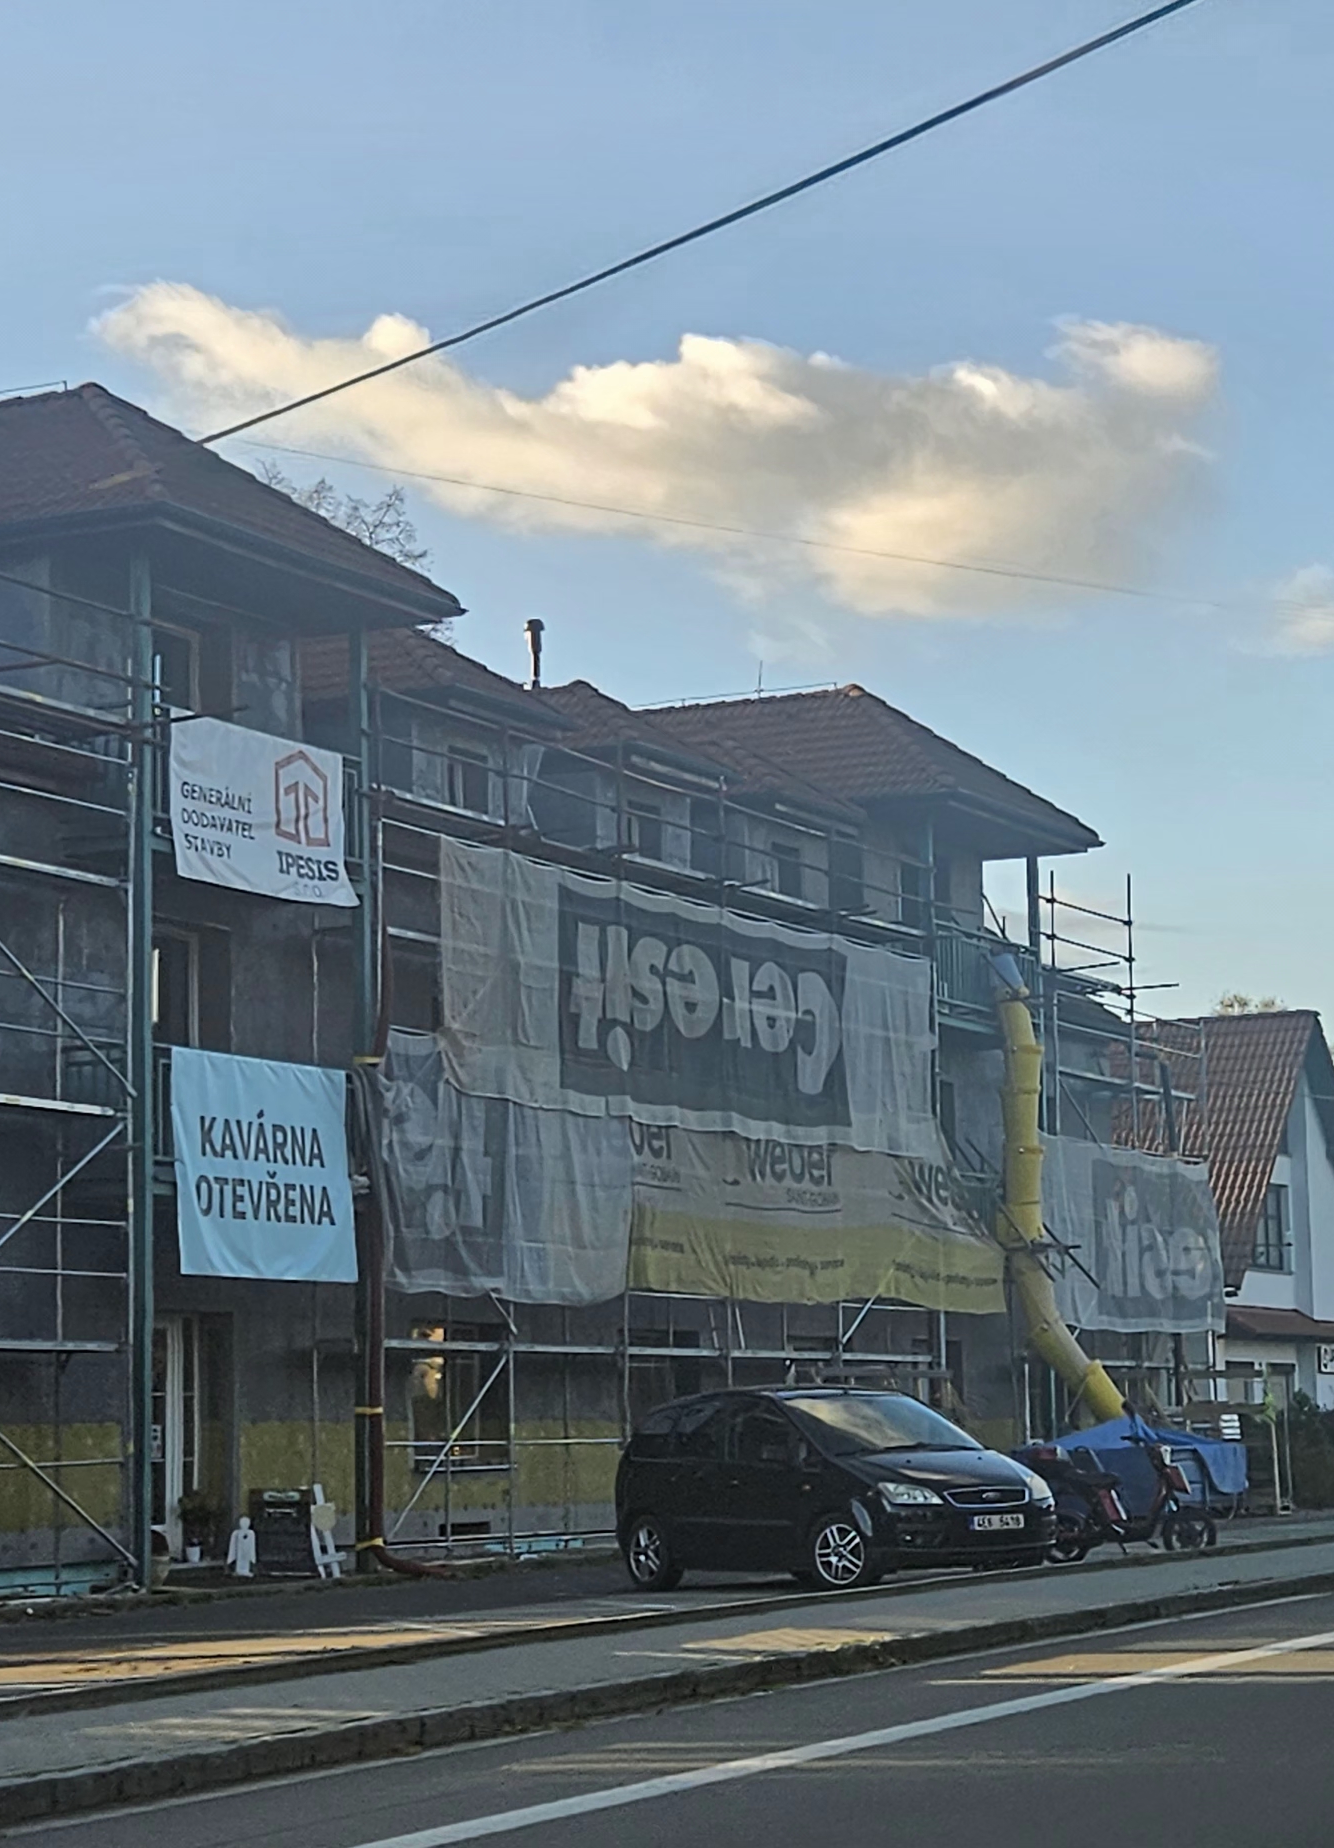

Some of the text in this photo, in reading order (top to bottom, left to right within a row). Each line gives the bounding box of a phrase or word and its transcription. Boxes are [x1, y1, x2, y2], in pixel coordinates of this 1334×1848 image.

[181, 780, 253, 815] GENERÁLNÍ
[181, 807, 256, 841] DODAVATEL
[184, 833, 232, 860] STAVBY
[277, 850, 340, 882] IPESIS
[570, 920, 842, 1095] Ceresit
[199, 1109, 326, 1169] KAVÁRNA
[195, 1170, 336, 1226] OTEVŘENA
